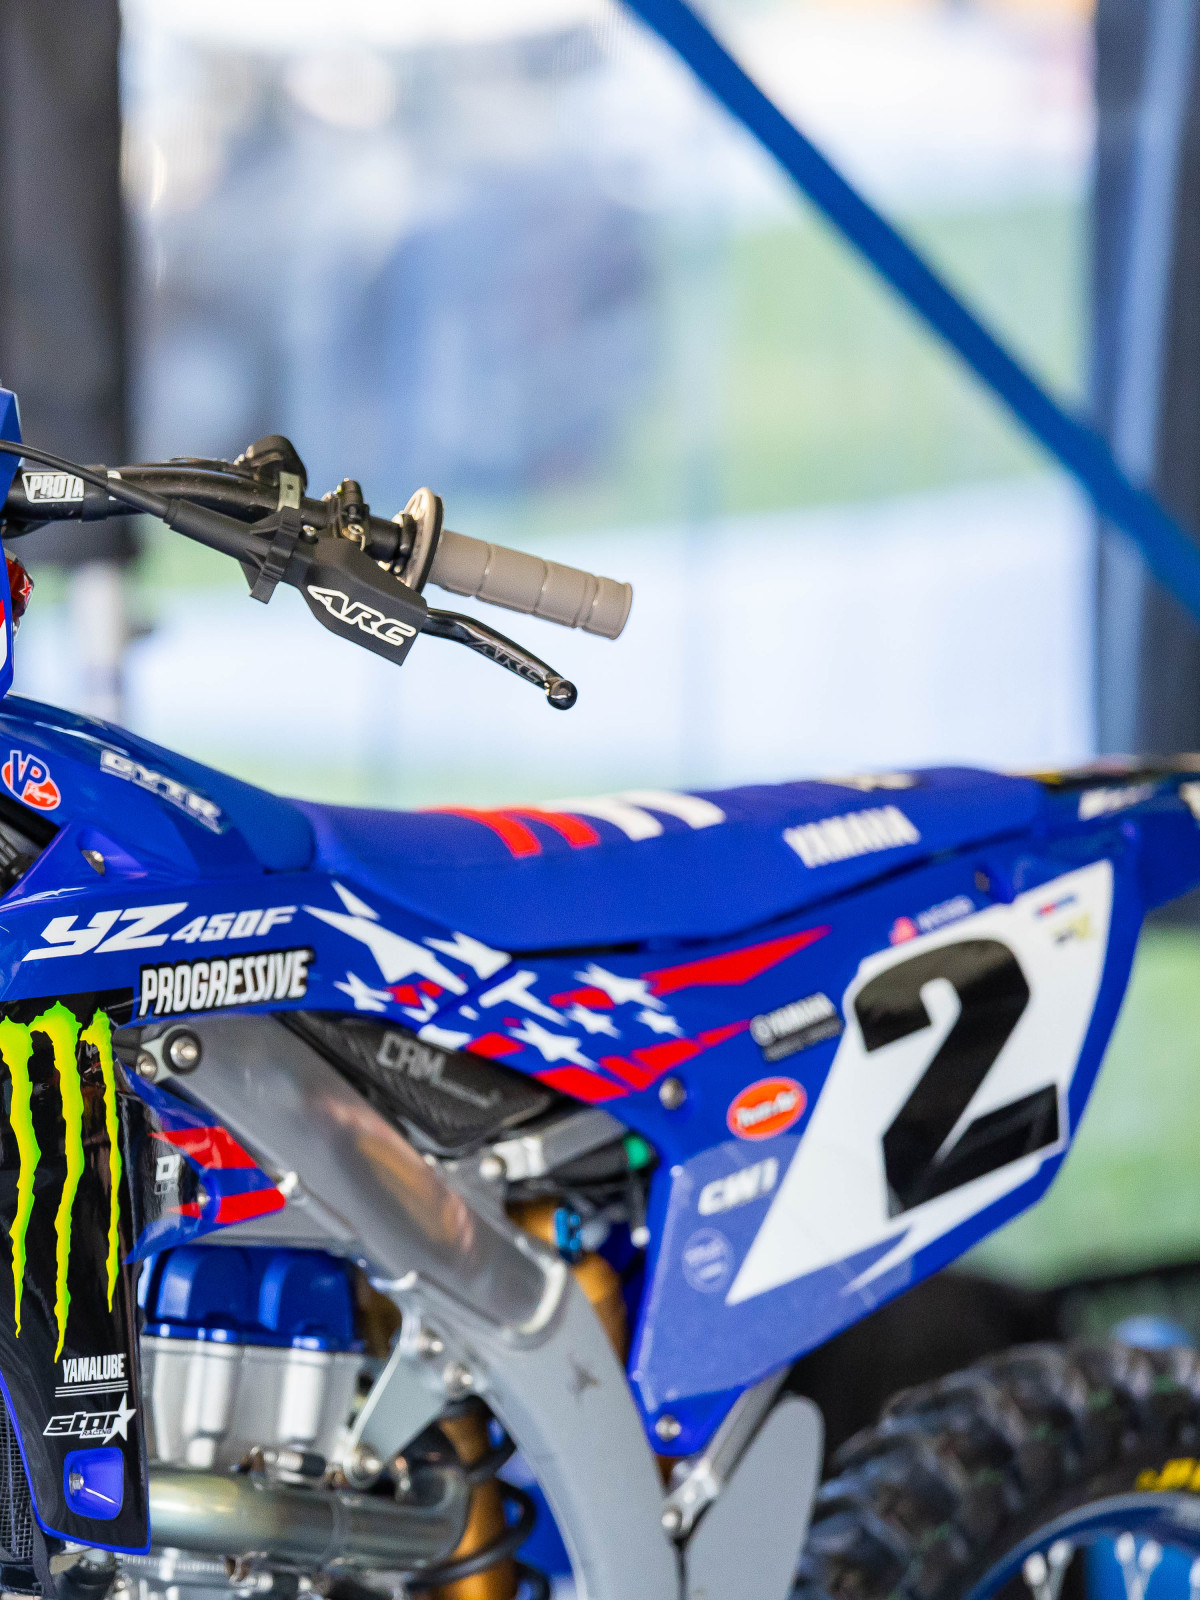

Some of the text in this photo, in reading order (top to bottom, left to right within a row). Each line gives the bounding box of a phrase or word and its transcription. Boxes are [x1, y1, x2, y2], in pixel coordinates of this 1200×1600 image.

[307, 585, 416, 646] ARC
[9, 750, 50, 799] VP
[171, 905, 298, 943] 450F
[138, 951, 308, 1016] PROGRESSIVE
[853, 938, 1060, 1220] 2
[62, 1353, 126, 1383] YAMALUBE
